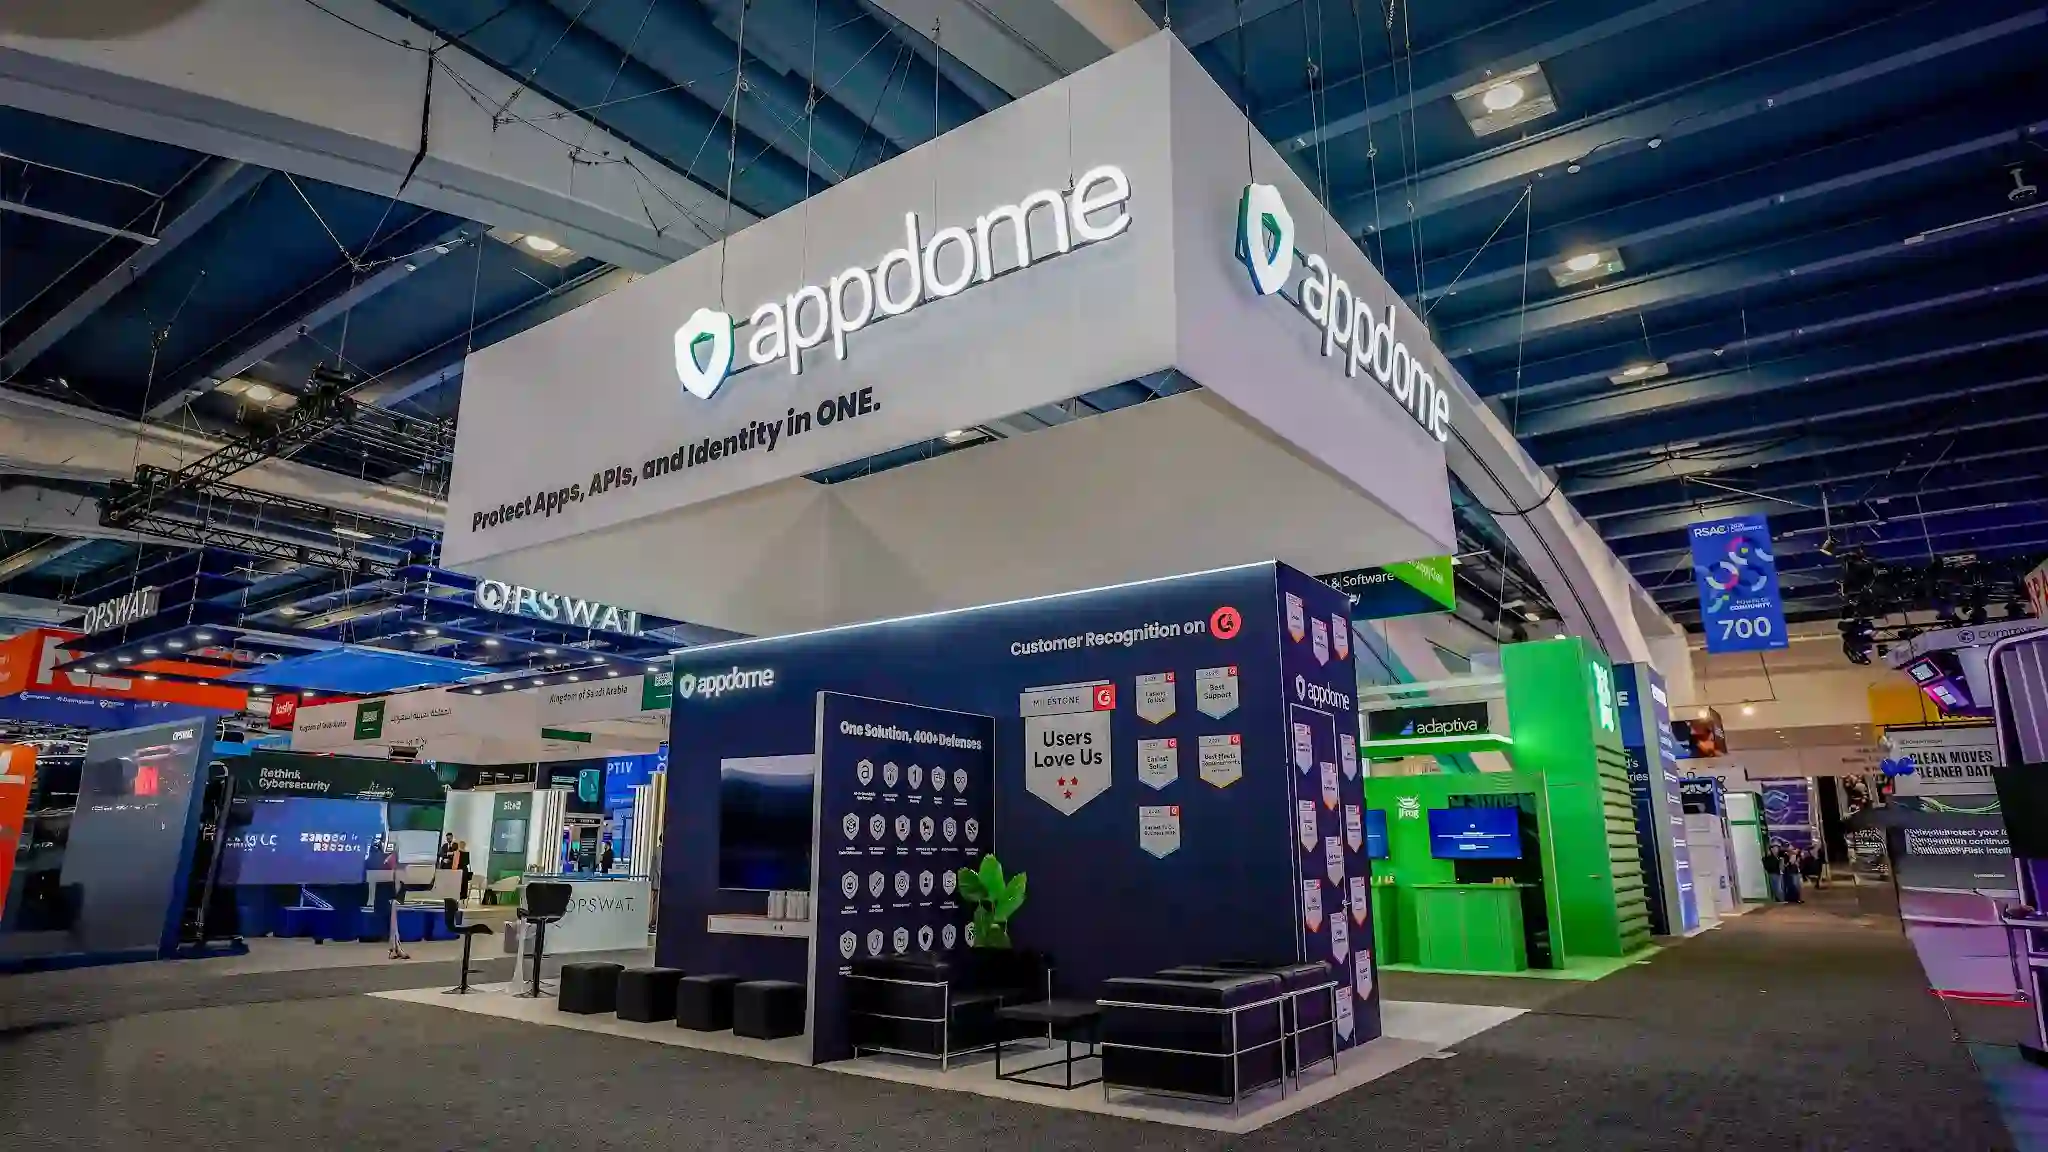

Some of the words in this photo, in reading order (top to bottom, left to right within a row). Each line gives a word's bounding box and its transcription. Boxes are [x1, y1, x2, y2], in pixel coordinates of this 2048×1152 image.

[748, 164, 1132, 376] appdome
[1299, 253, 1449, 442] appdome
[472, 500, 532, 532] Protect
[533, 483, 585, 519] Apps,
[588, 466, 638, 498] APIs,
[642, 446, 684, 480] and
[688, 420, 783, 469] Identity
[787, 408, 811, 438] in
[816, 386, 881, 426] ONE.
[1693, 525, 1727, 538] RSAC
[1342, 572, 1395, 588] Software
[1010, 635, 1083, 657] Customer
[1086, 621, 1181, 647] Recognition
[1184, 619, 1206, 635] on
[1718, 616, 1772, 641] 700
[697, 666, 775, 698] appdome
[549, 693, 577, 704] Kingdom
[578, 689, 586, 700] of
[606, 684, 628, 696] Arabia
[1203, 691, 1232, 700] Support
[1307, 681, 1350, 711] appdome
[839, 720, 864, 736] One
[864, 723, 913, 744] Solution,
[939, 733, 982, 750] Defenses
[1416, 717, 1478, 737] adaptiva
[1043, 730, 1093, 748] Users
[1034, 751, 1076, 768] Love
[1080, 748, 1103, 766] Us
[1949, 750, 1993, 764] MOVES
[260, 767, 301, 780] Rethink
[258, 778, 331, 792] Cybersecurity
[1977, 829, 2000, 837] your
